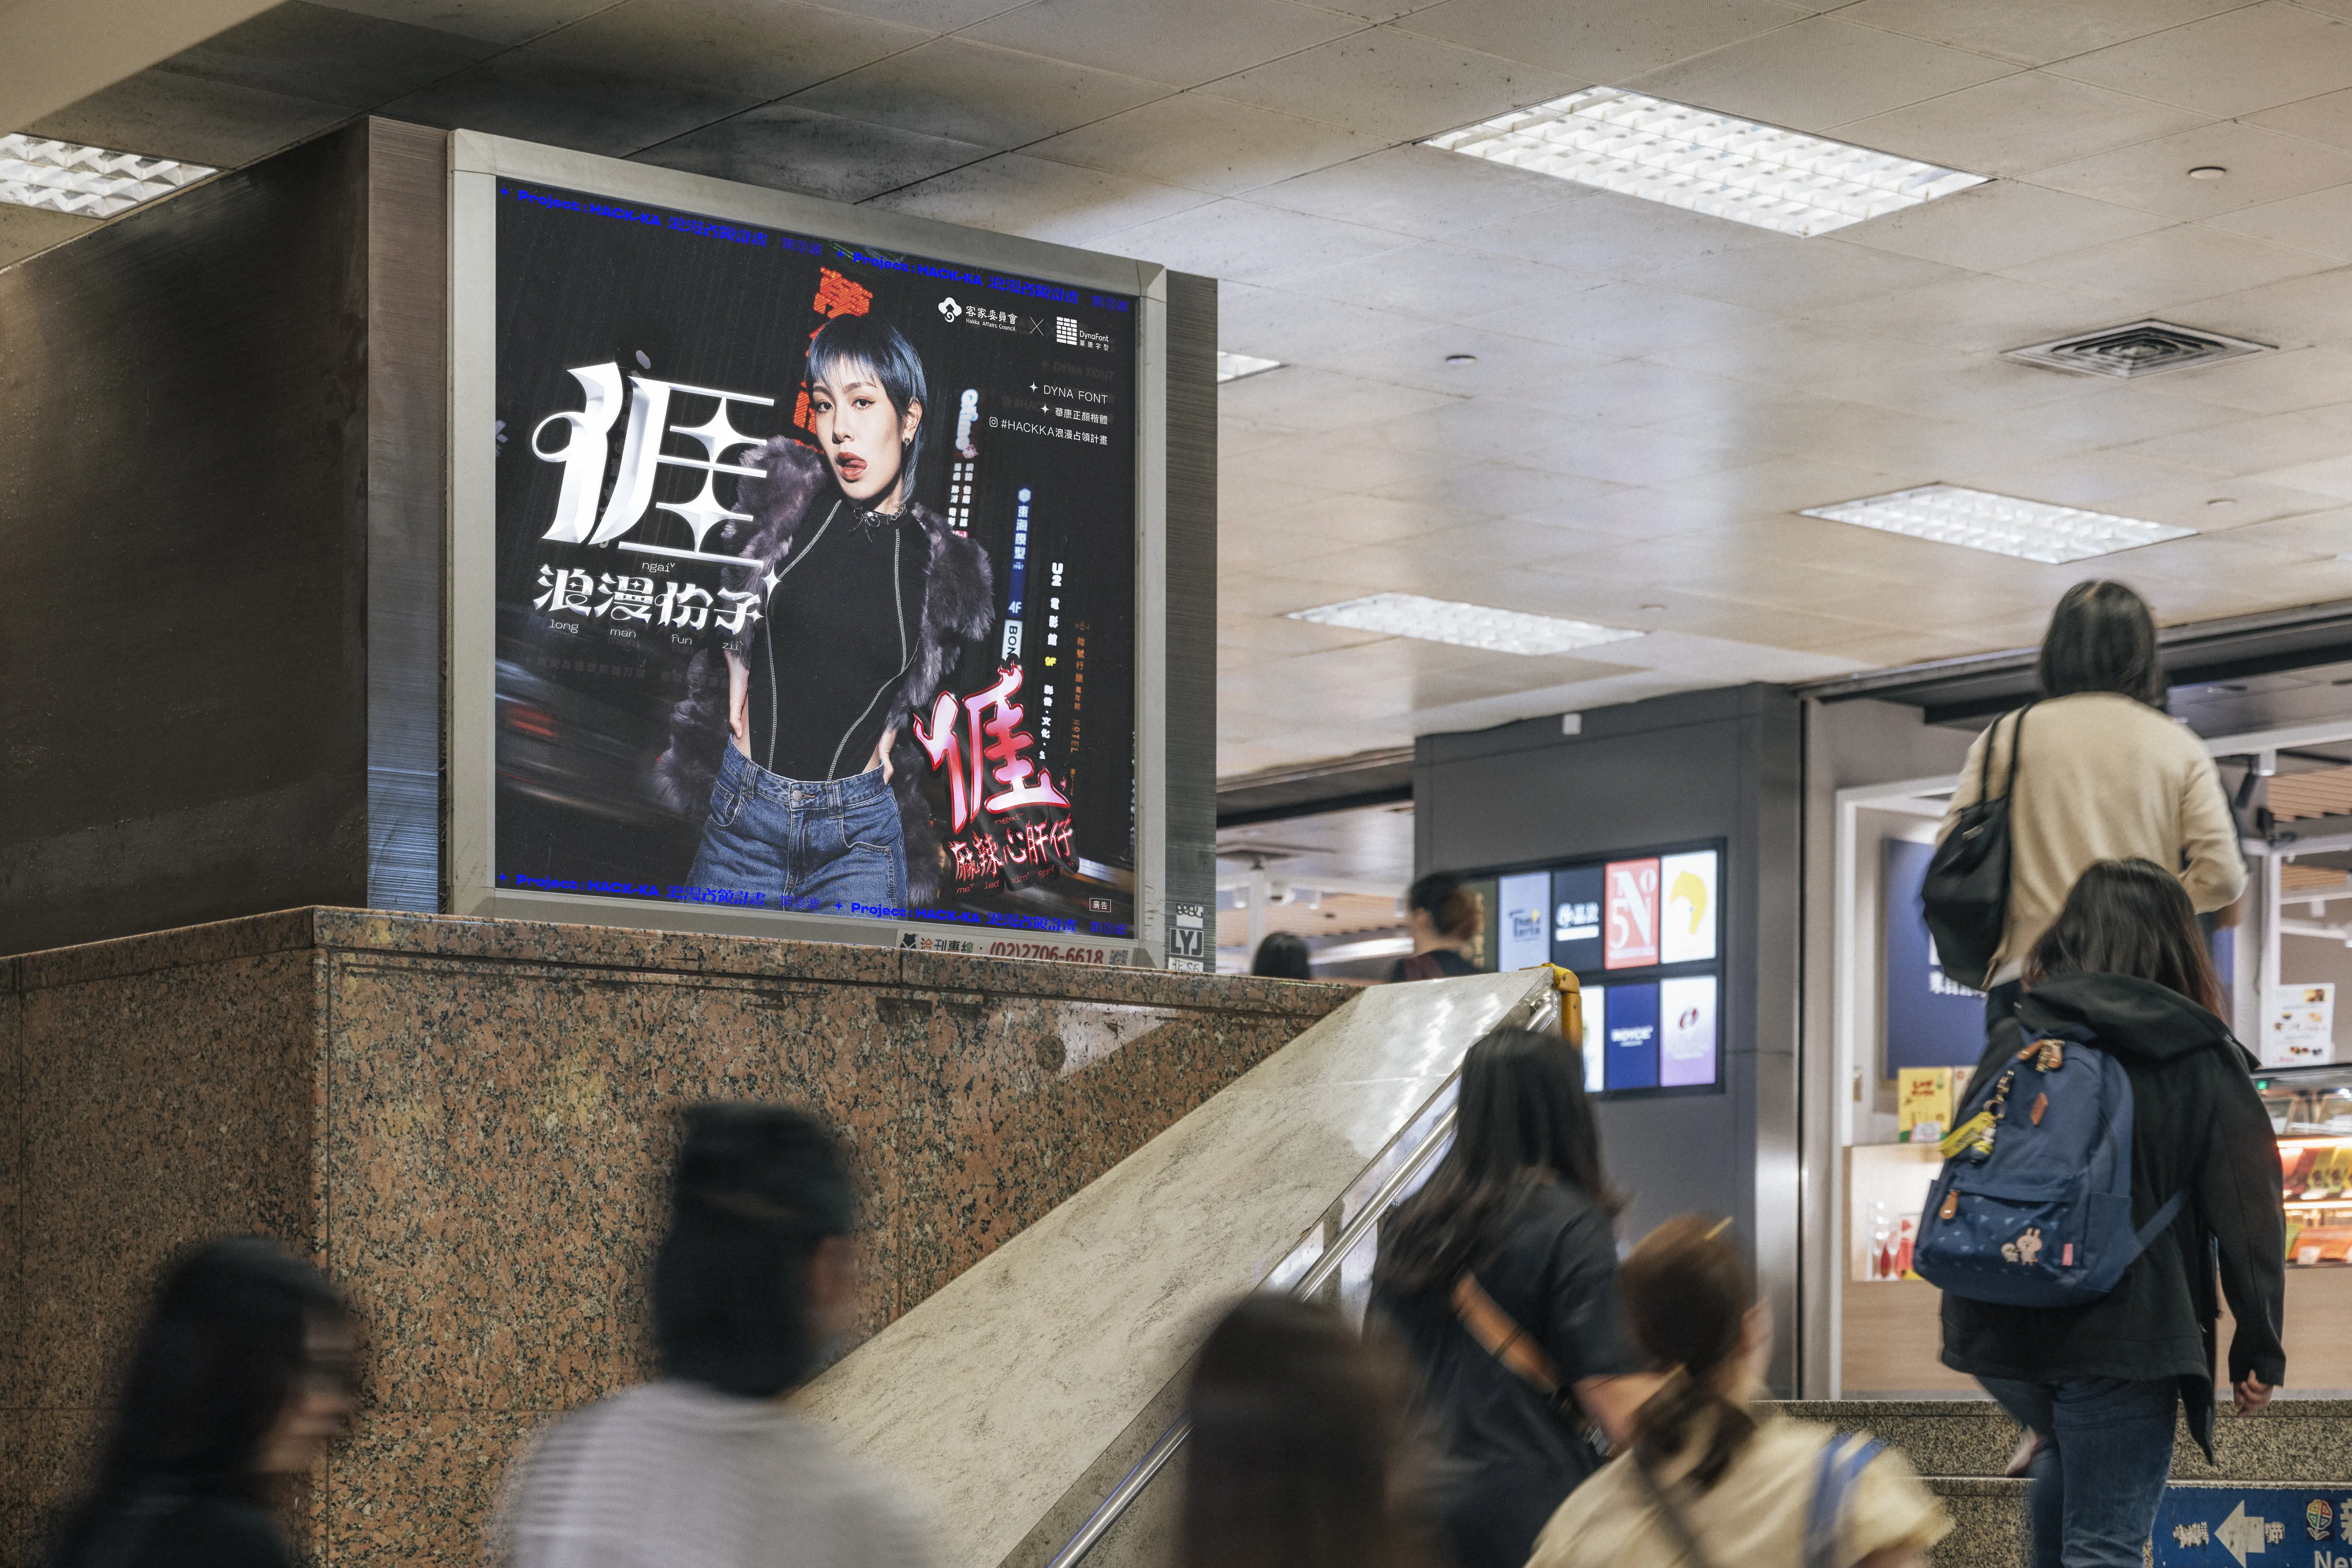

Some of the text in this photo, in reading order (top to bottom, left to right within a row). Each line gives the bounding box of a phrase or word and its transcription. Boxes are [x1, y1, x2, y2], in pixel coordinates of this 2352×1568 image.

[590, 203, 661, 227] HACK-KA
[918, 264, 983, 286] HACK-KA
[966, 306, 1018, 325] 客家委員會
[1080, 330, 1109, 342] DynaFont
[1080, 340, 1109, 351] 華康字型
[1044, 385, 1108, 404] DYNA FONT
[533, 565, 764, 635] 浪漫份子
[1008, 601, 1022, 614] 4F
[549, 619, 579, 634] long
[610, 628, 636, 638] man
[672, 634, 693, 645] fun
[1070, 719, 1081, 753] HOTEL
[948, 813, 1073, 883] 麻辣心肝仔
[588, 880, 660, 897] HACK-KA
[984, 880, 1000, 890] lad
[916, 907, 981, 923] HACK-KA
[1093, 901, 1108, 911] 廣告
[1170, 929, 1203, 956] LYJ
[990, 941, 1104, 964] (02)2706-6618
[2314, 1551, 2352, 1568] Ne
